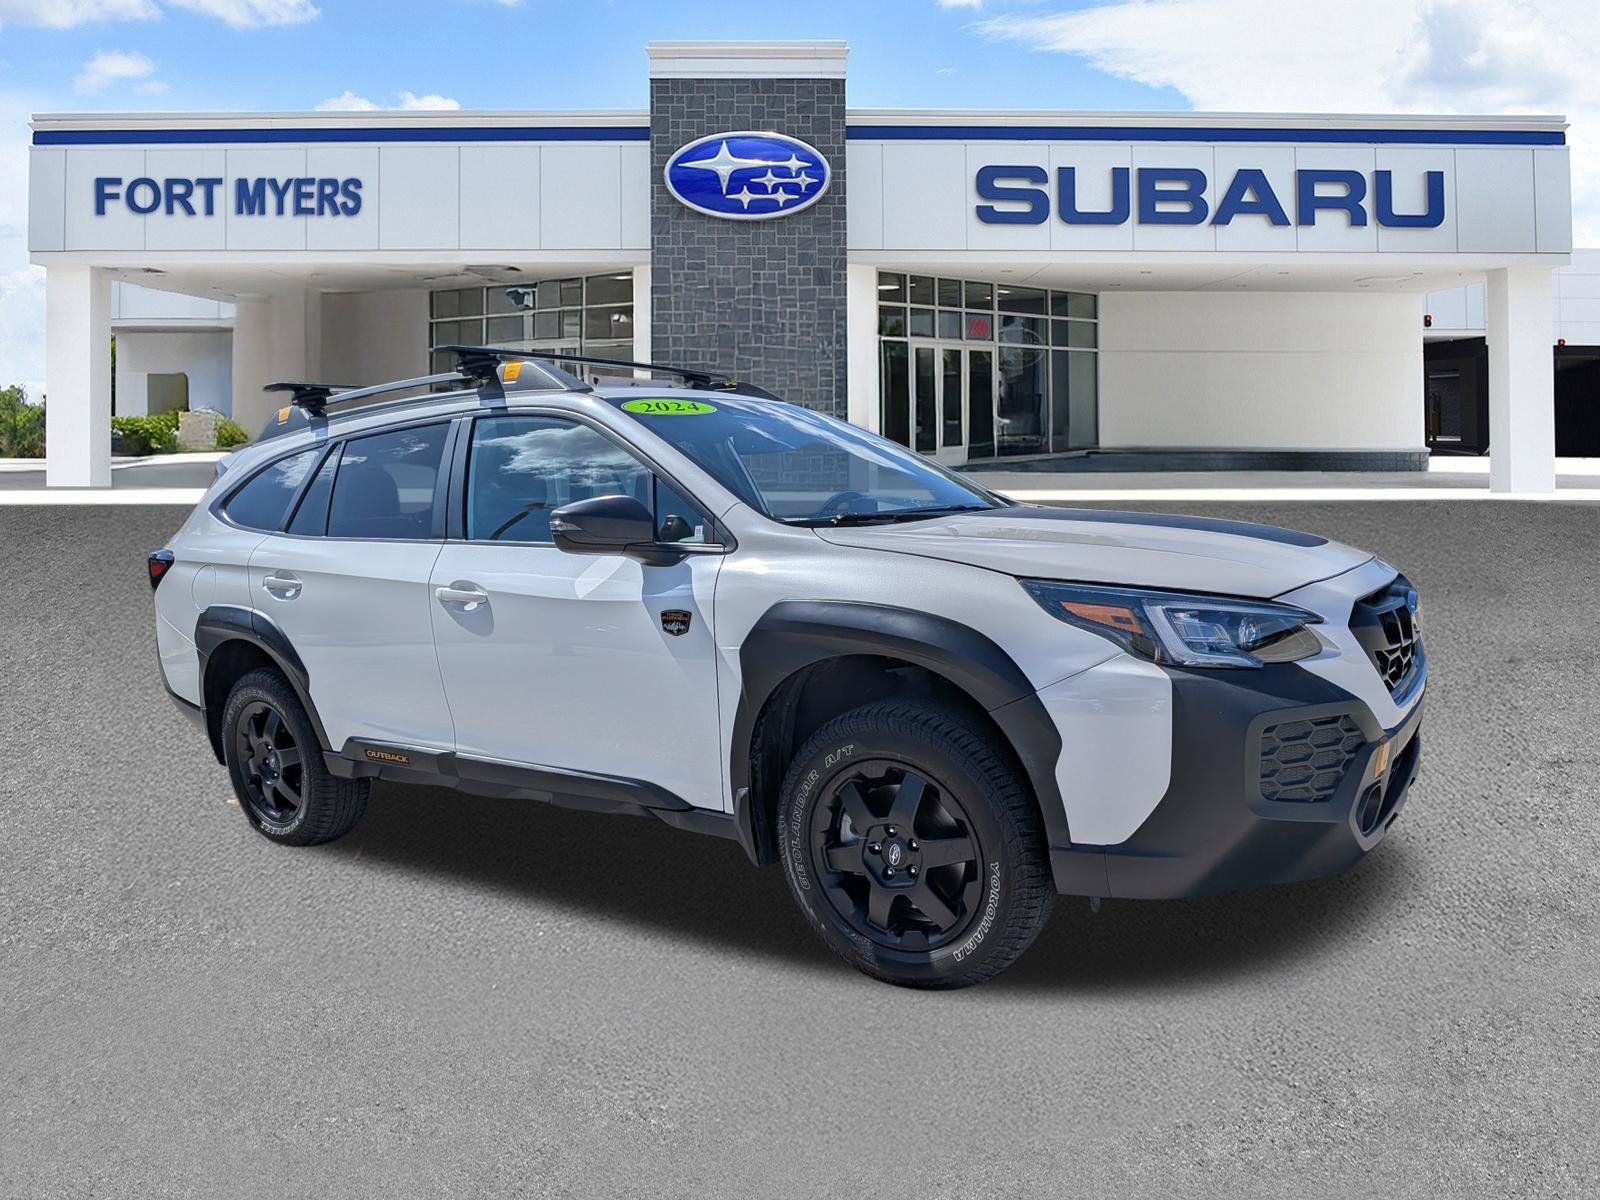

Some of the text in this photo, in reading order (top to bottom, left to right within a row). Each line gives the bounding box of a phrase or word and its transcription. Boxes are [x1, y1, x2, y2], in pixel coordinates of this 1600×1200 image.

[95, 178, 363, 216] FORT MYERS
[976, 165, 1445, 228] SUBARU
[640, 401, 700, 413] 2024
[366, 750, 409, 763] OUTBACK
[791, 744, 855, 890] GEOLANDAR A/T
[953, 861, 1001, 962] YOKOHAMA
